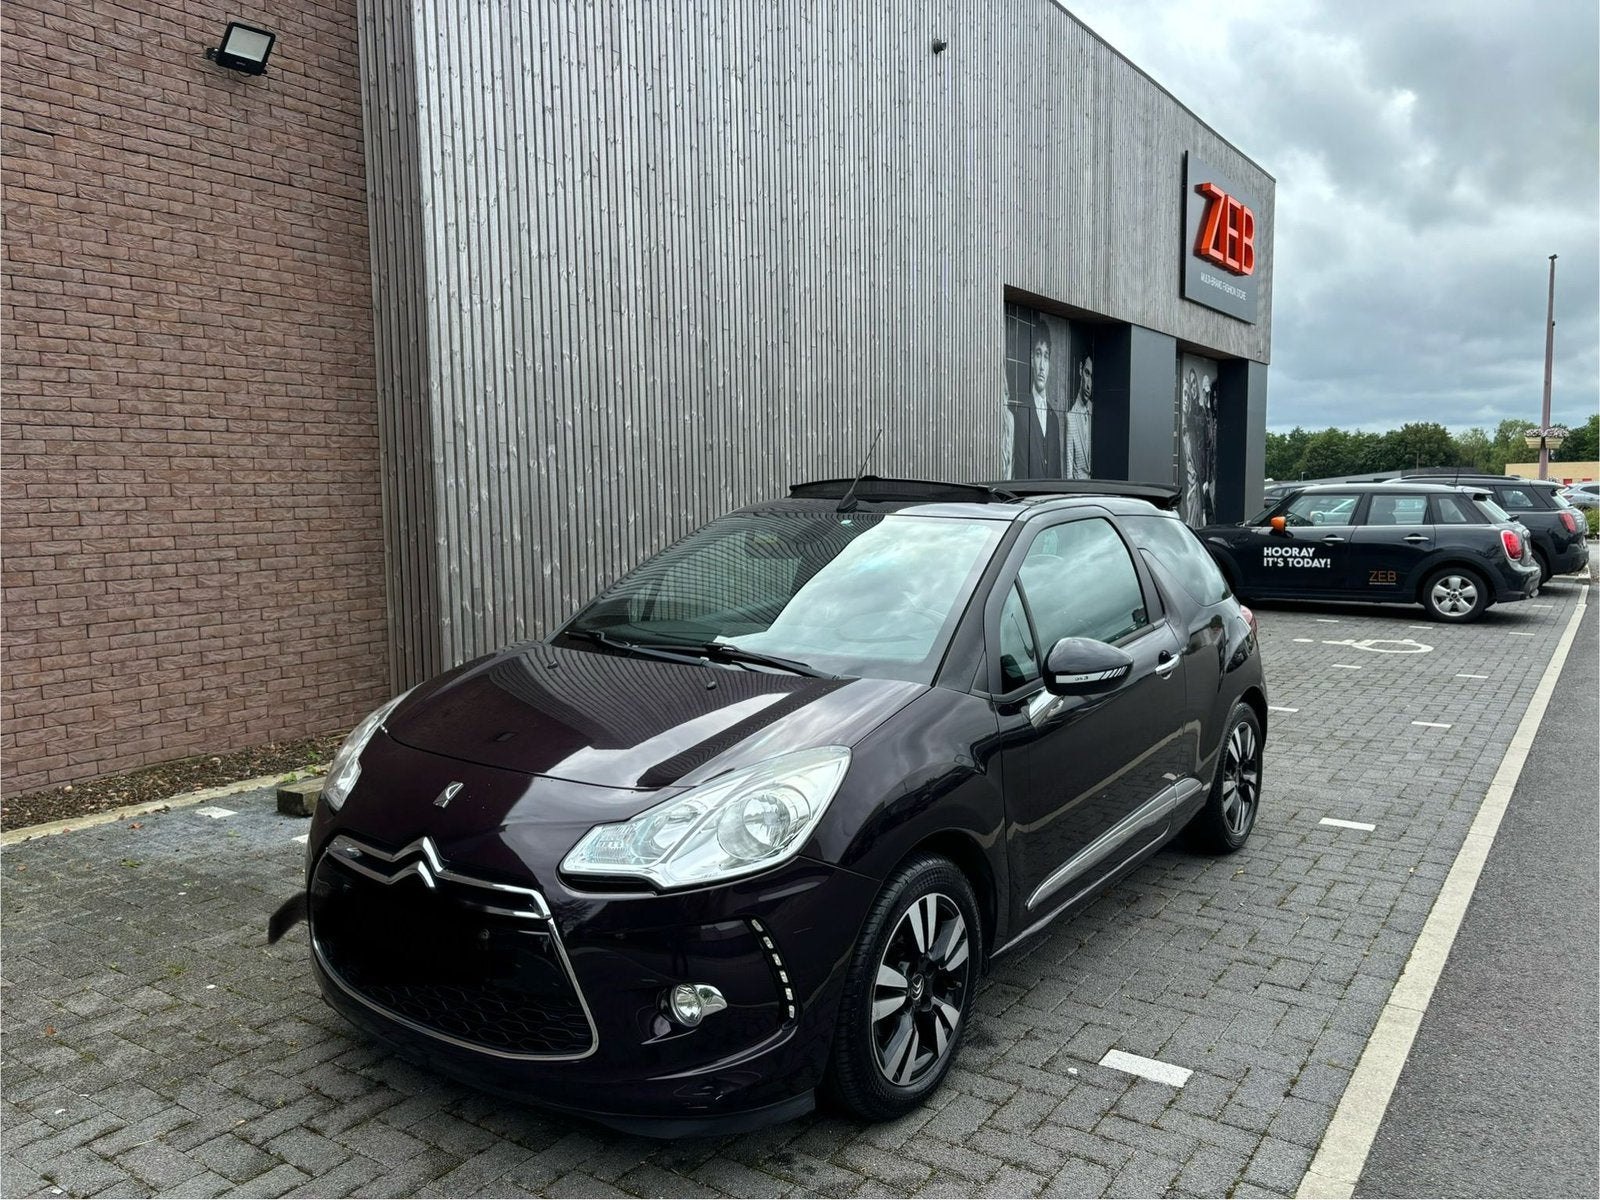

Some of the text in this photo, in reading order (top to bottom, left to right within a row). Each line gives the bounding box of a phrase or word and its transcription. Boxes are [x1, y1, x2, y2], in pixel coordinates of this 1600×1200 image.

[1195, 182, 1255, 276] ZEB
[1263, 547, 1315, 557] HOORAY
[1263, 557, 1331, 568] IT'S TODAY!
[1368, 570, 1397, 582] ZEB
